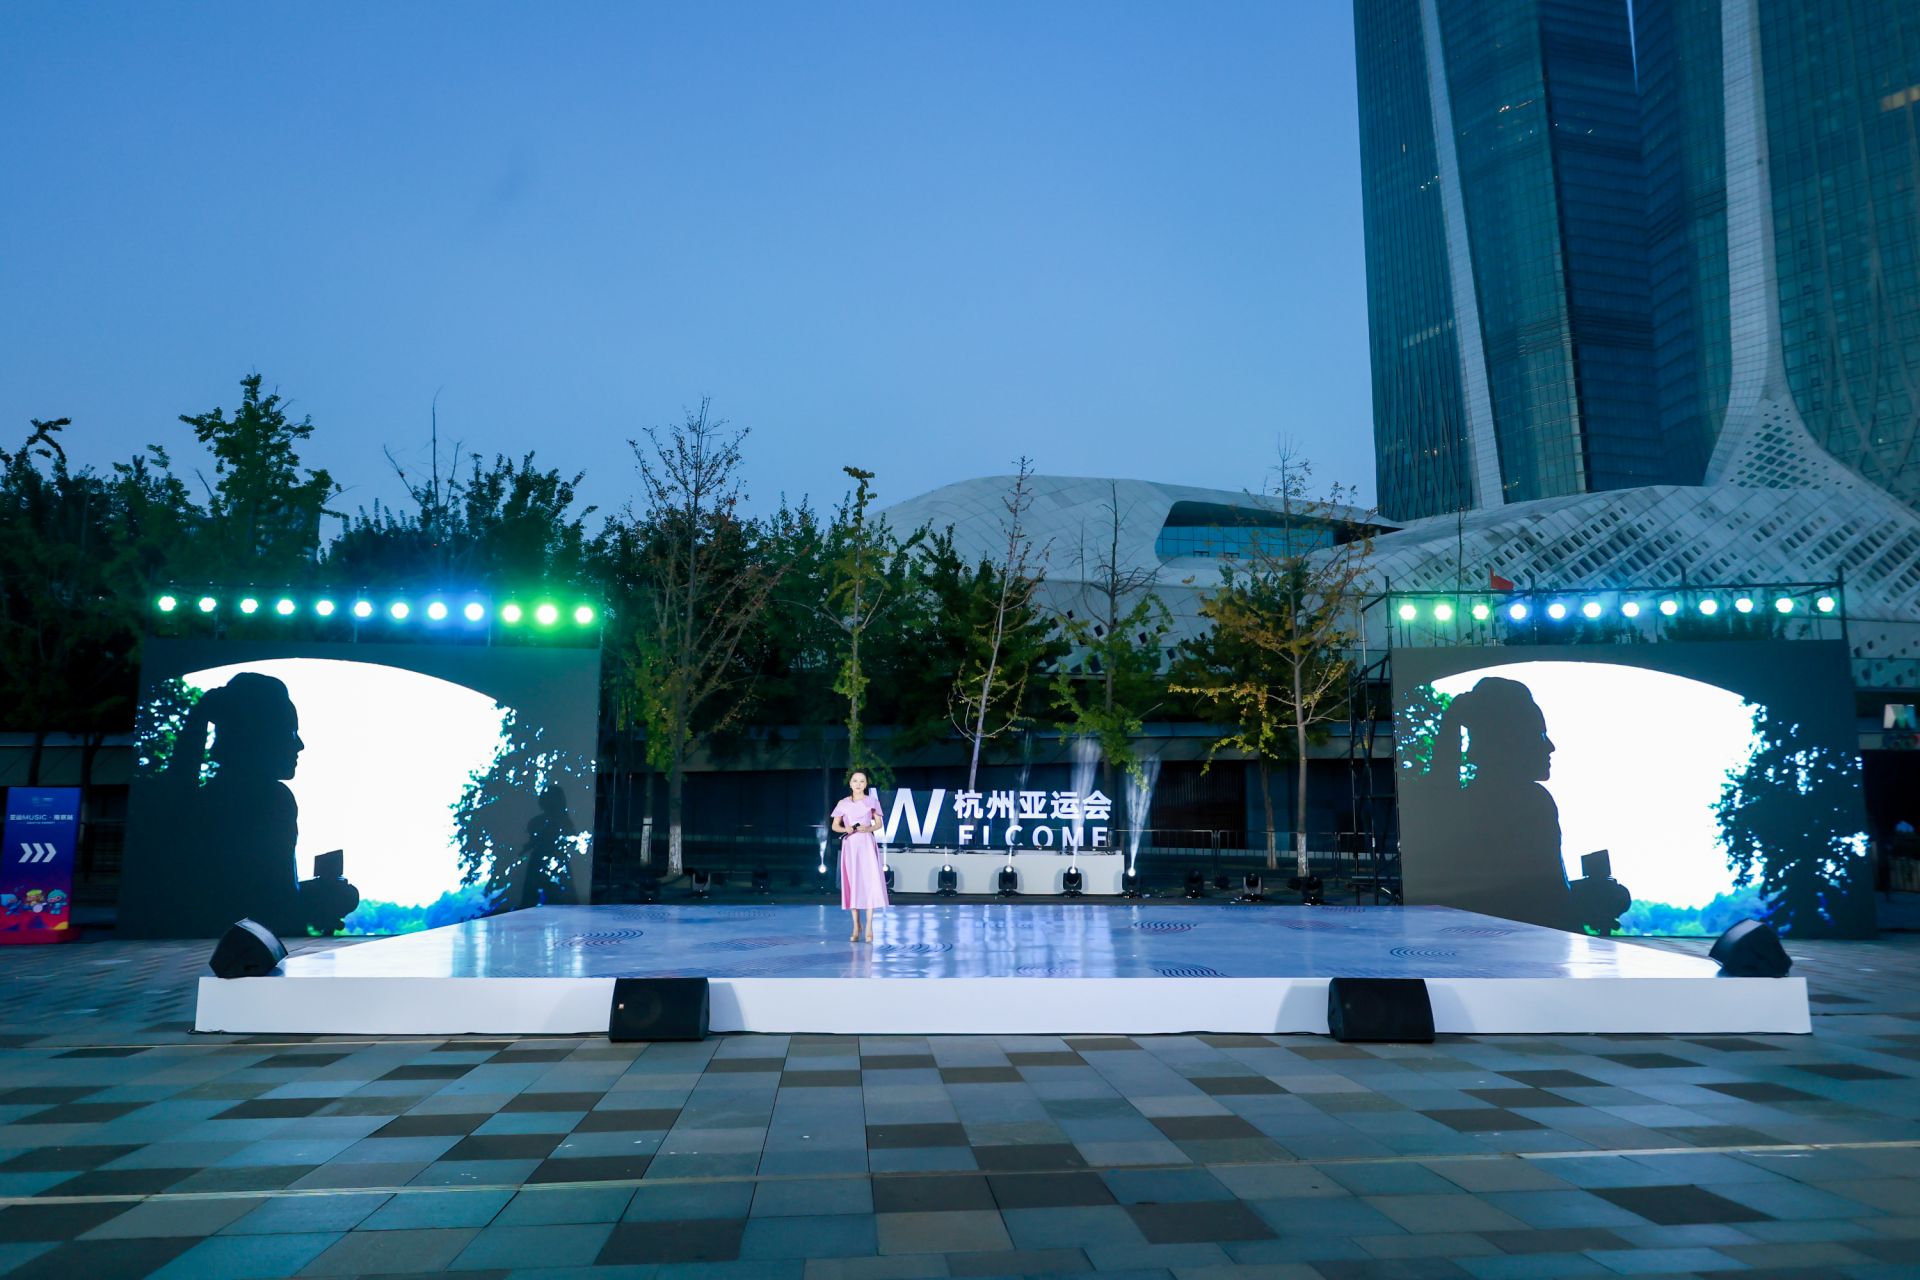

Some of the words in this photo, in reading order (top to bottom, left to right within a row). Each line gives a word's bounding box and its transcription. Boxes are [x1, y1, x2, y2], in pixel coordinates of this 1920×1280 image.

[953, 789, 1112, 820] 杭州亚运会
